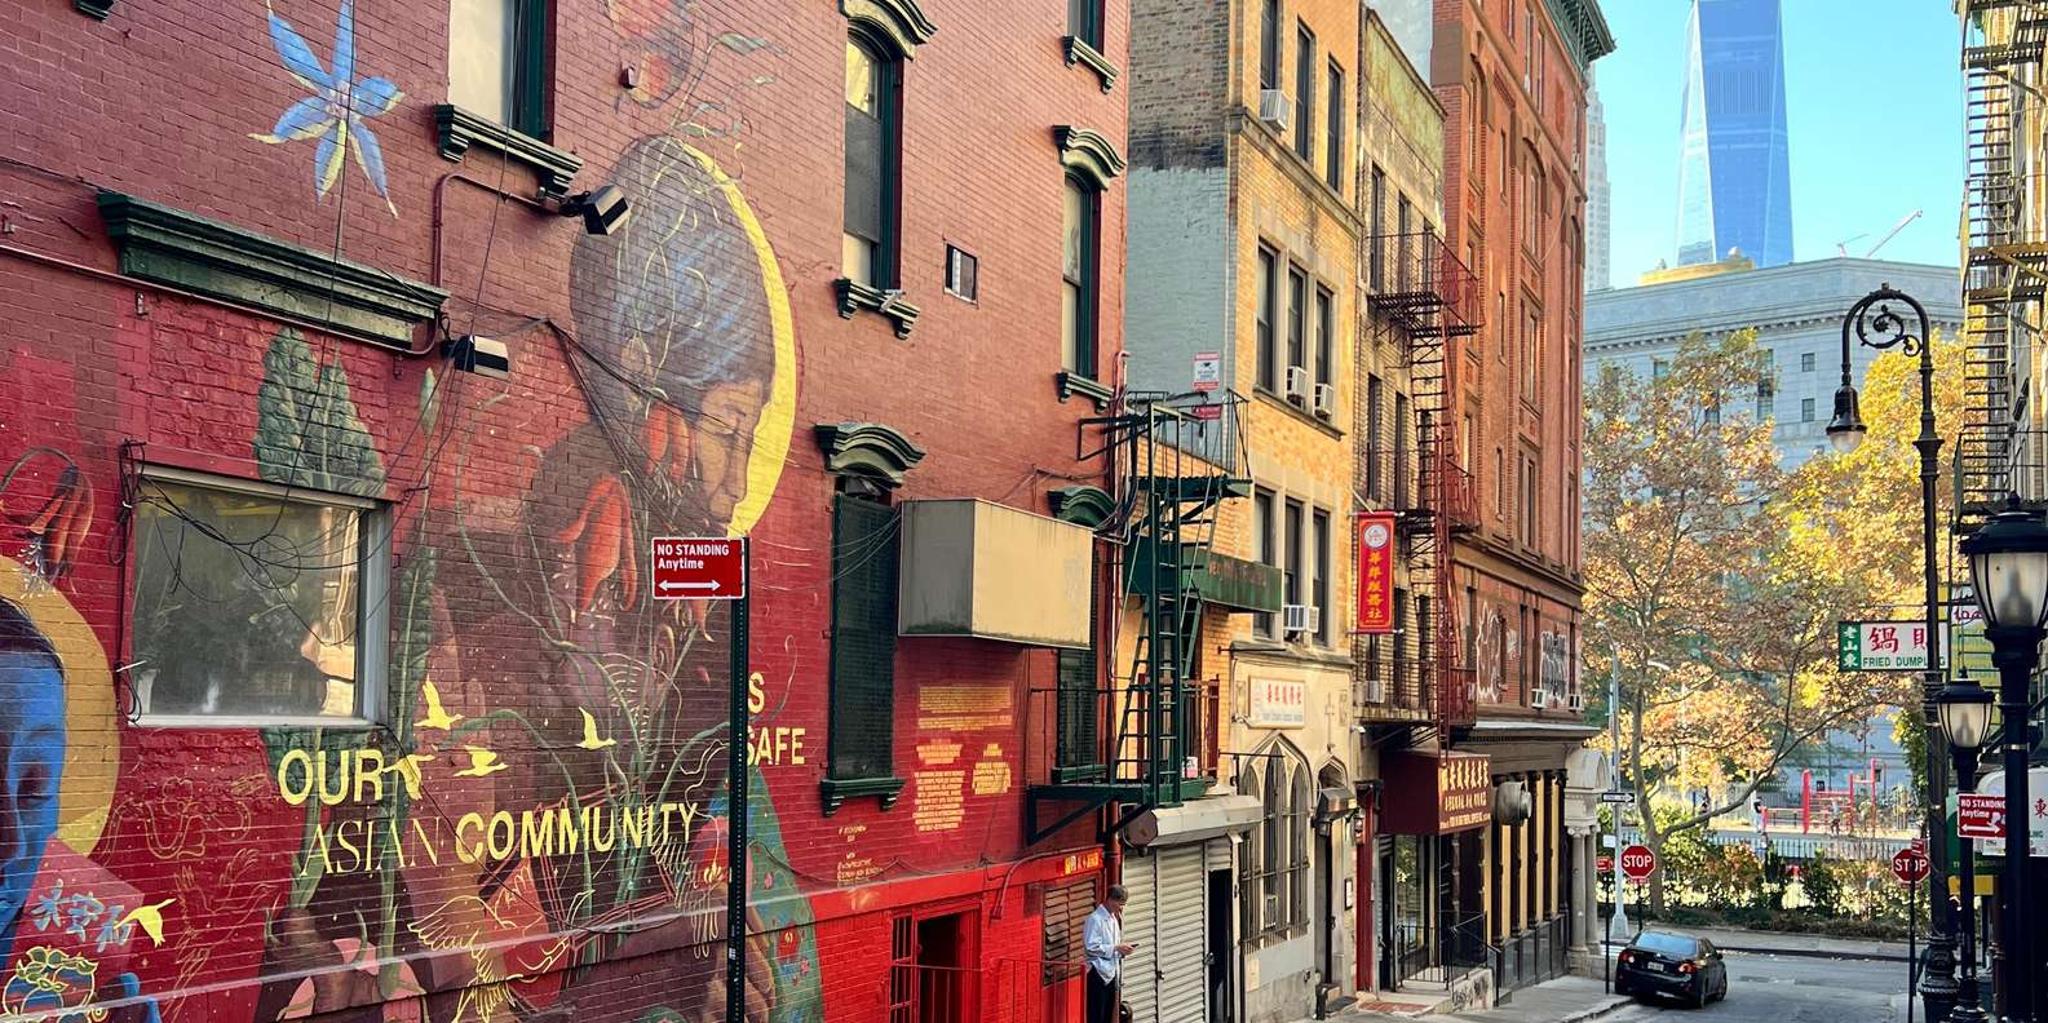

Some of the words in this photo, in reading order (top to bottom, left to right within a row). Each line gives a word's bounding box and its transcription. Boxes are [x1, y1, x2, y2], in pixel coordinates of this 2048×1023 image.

[657, 544, 673, 556] NO
[675, 544, 730, 556] STANDING
[658, 557, 704, 572] Anytime
[1843, 625, 1859, 668] 老山東
[1863, 657, 1891, 667] FRIED
[1896, 657, 1946, 667] DUMPLG
[278, 748, 383, 806] OUR
[1960, 799, 1971, 807] NO
[2034, 797, 2048, 819] 東
[1961, 809, 1990, 819] Anytime
[300, 817, 441, 877] ASIAN
[455, 803, 698, 865] COMMUNITY
[1623, 854, 1652, 868] STOP
